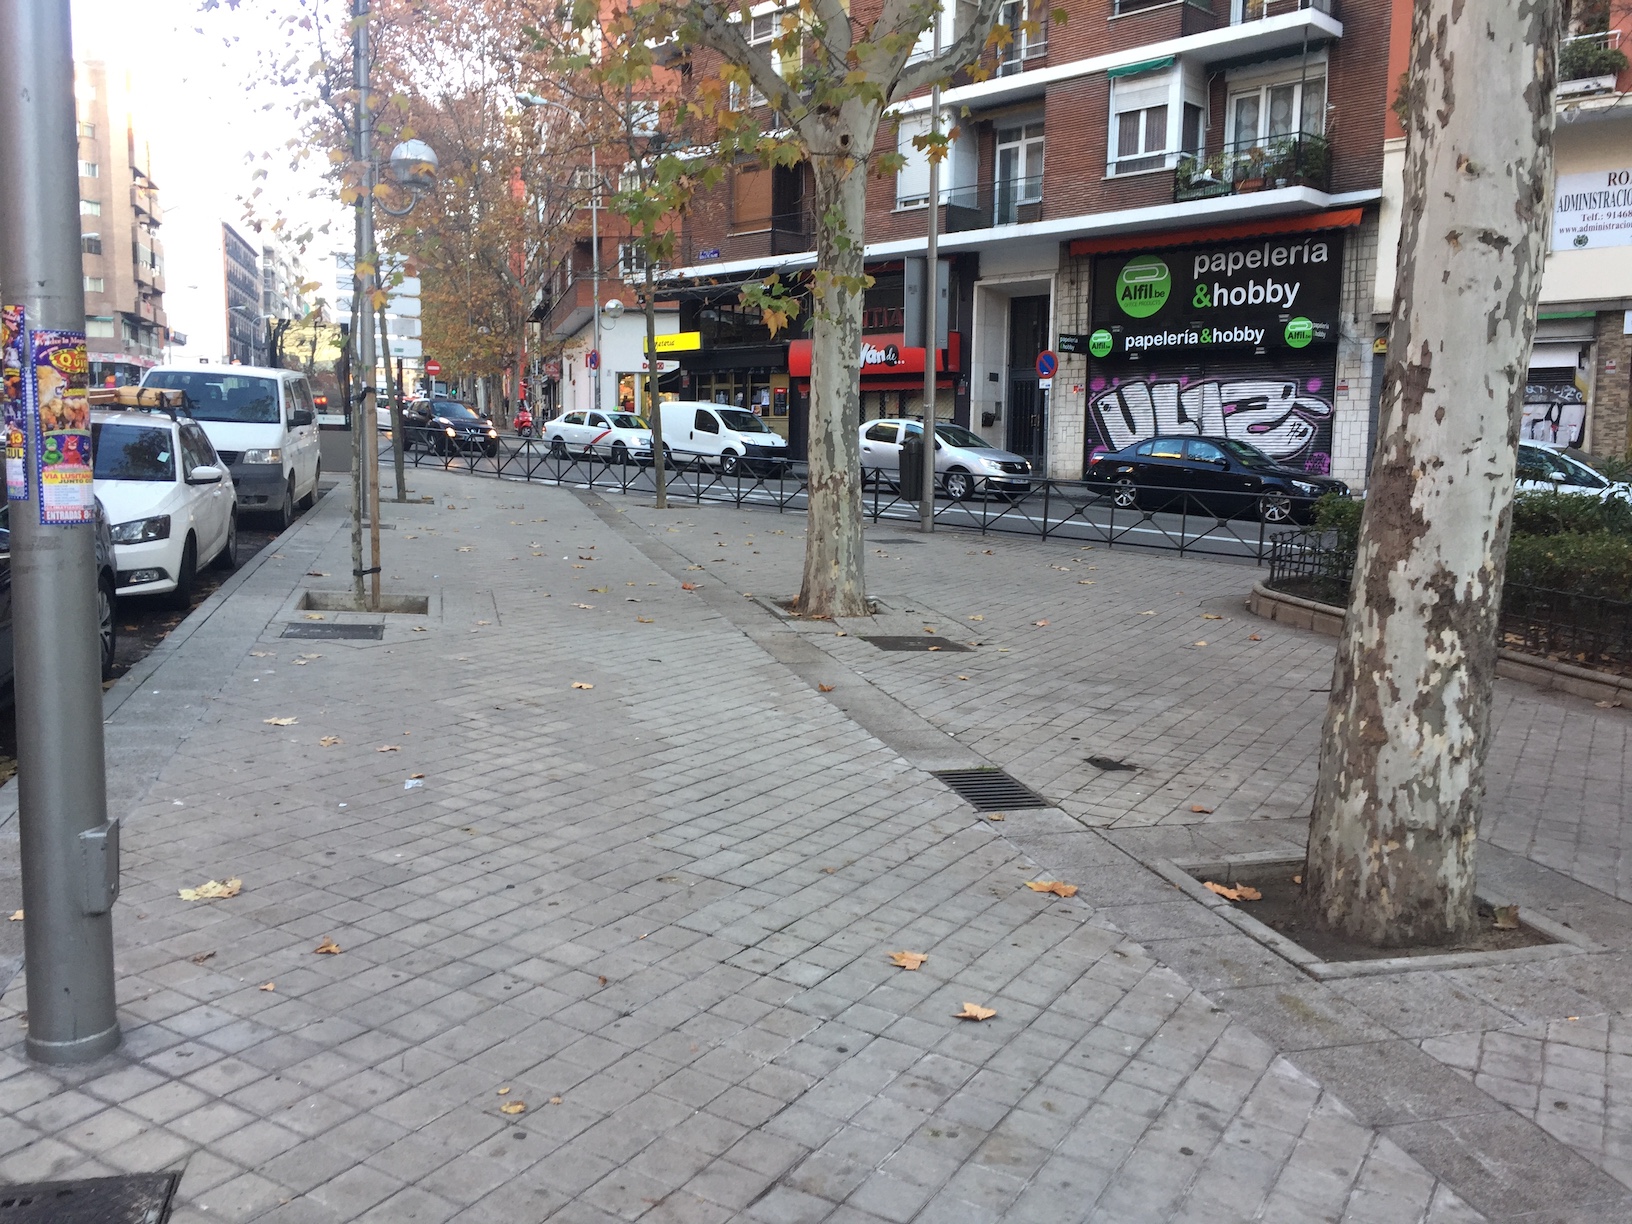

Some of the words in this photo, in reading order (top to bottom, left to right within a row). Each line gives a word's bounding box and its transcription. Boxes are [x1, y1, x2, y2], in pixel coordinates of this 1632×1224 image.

[1607, 170, 1632, 187] RO
[1193, 238, 1329, 280] papelería
[1192, 278, 1301, 309] &hobby
[46, 510, 82, 520] ENTRADAS
